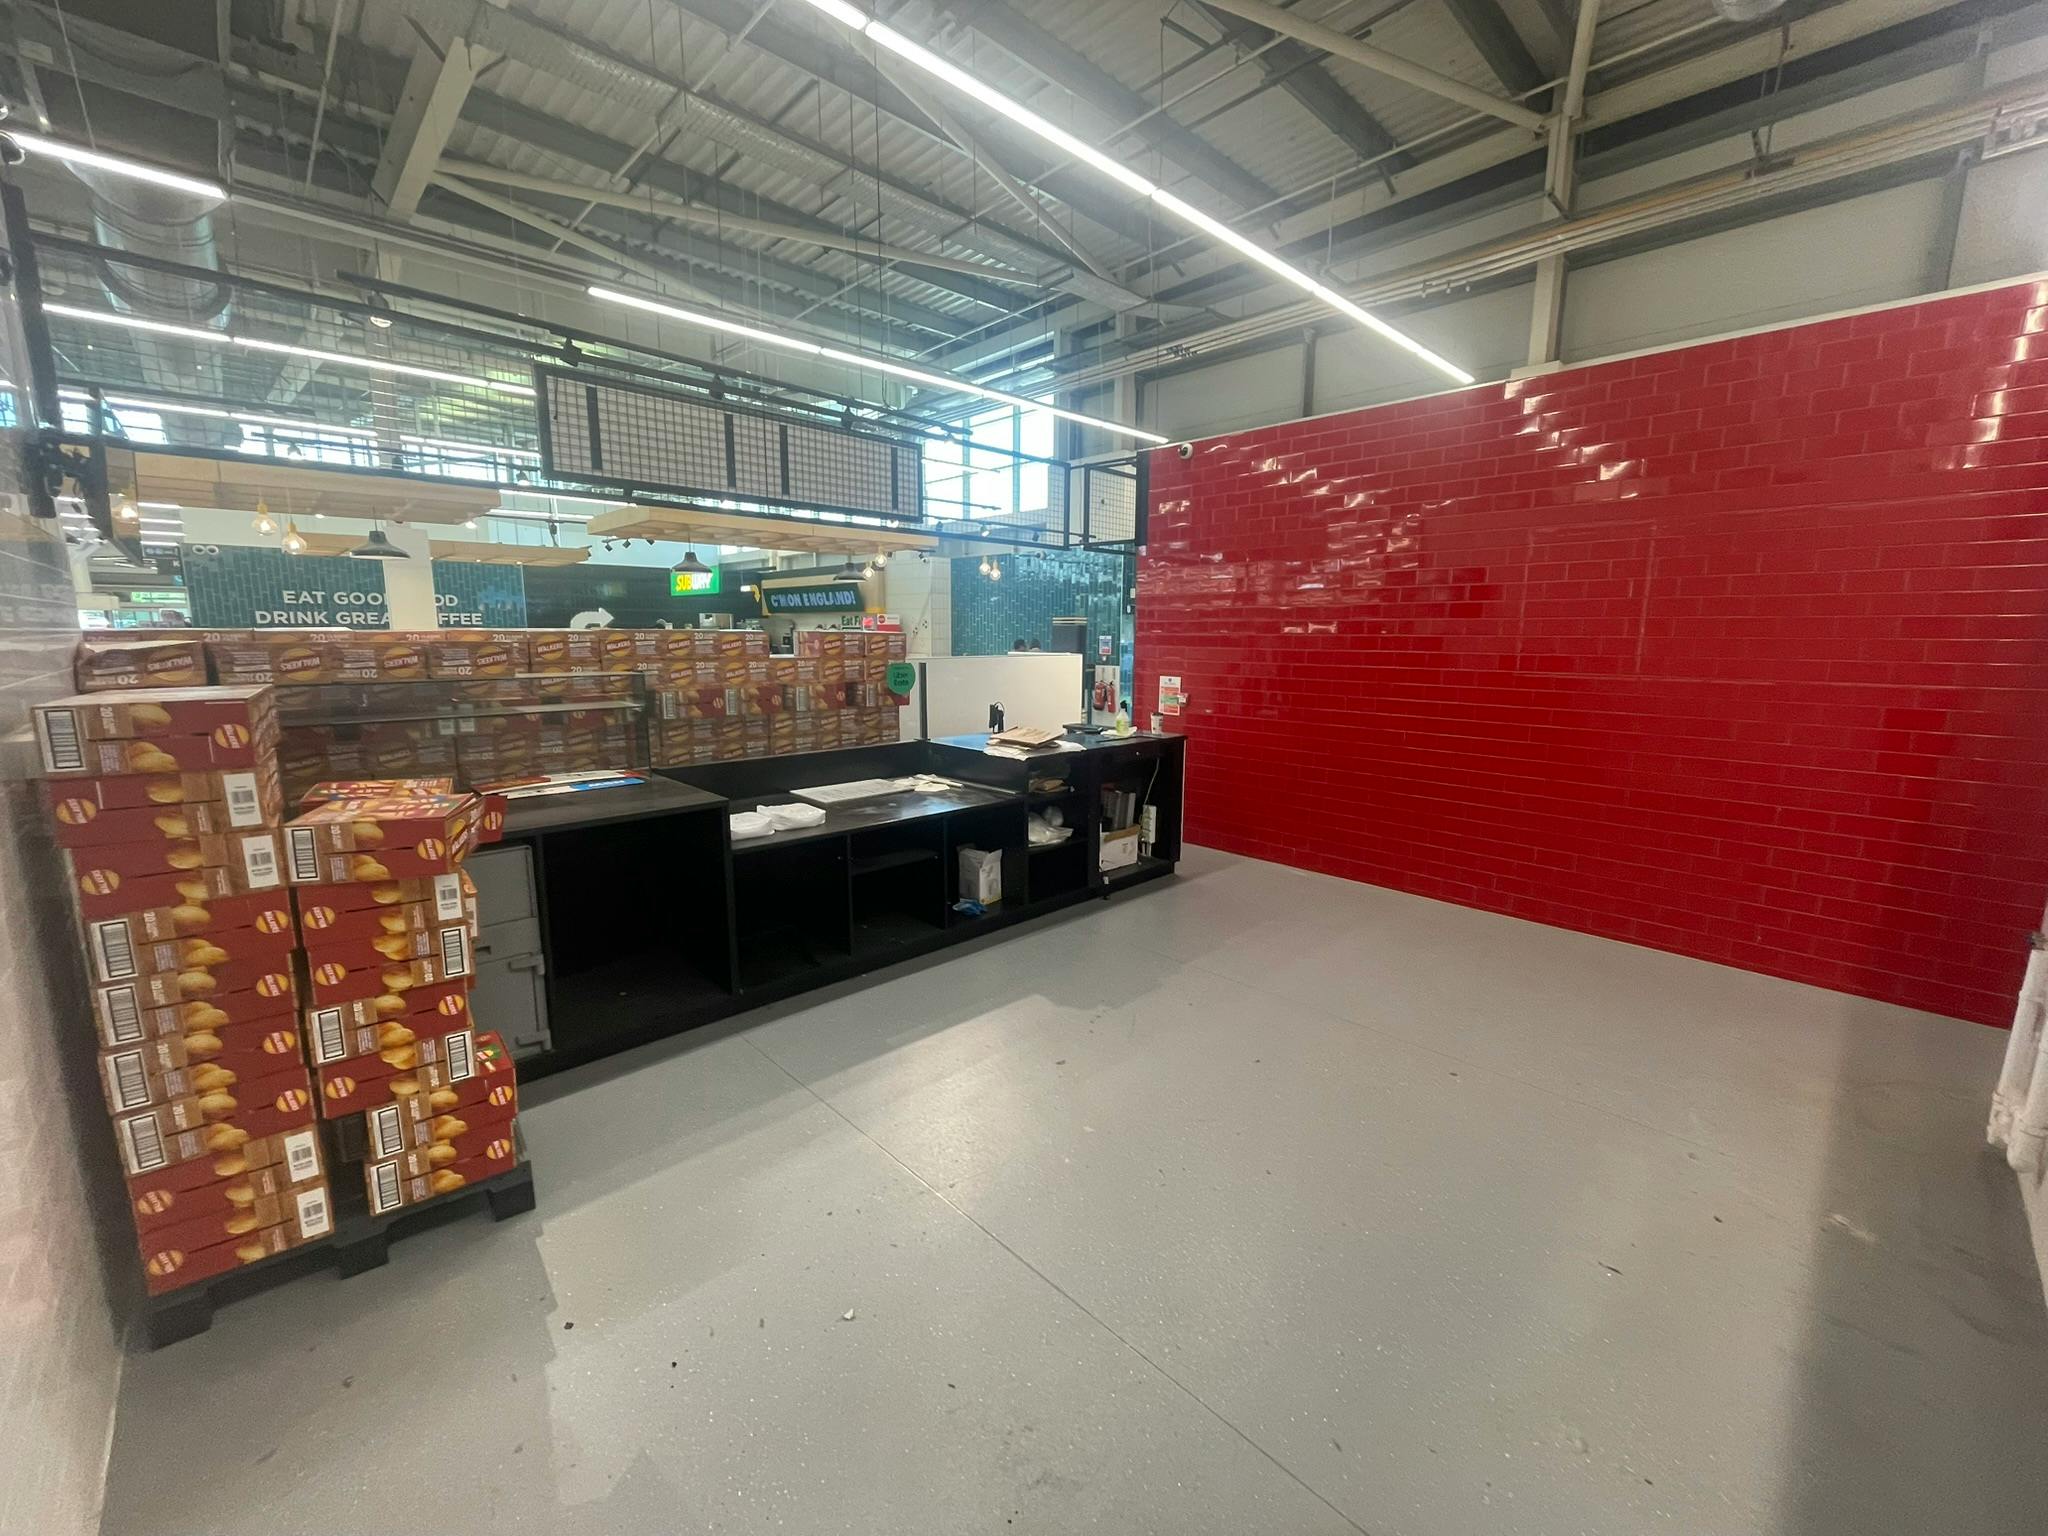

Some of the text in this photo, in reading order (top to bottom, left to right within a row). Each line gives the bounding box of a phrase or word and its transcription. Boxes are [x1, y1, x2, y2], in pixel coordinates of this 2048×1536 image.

[676, 573, 713, 591] SUBWAY
[282, 591, 326, 604] EAT
[771, 590, 856, 607] C'MON ENGLAND!
[255, 611, 328, 624] DRINK
[336, 612, 390, 624] GREA
[280, 656, 320, 671] WALKERS
[384, 655, 419, 669] WALKERS
[477, 653, 507, 665] WALKERS
